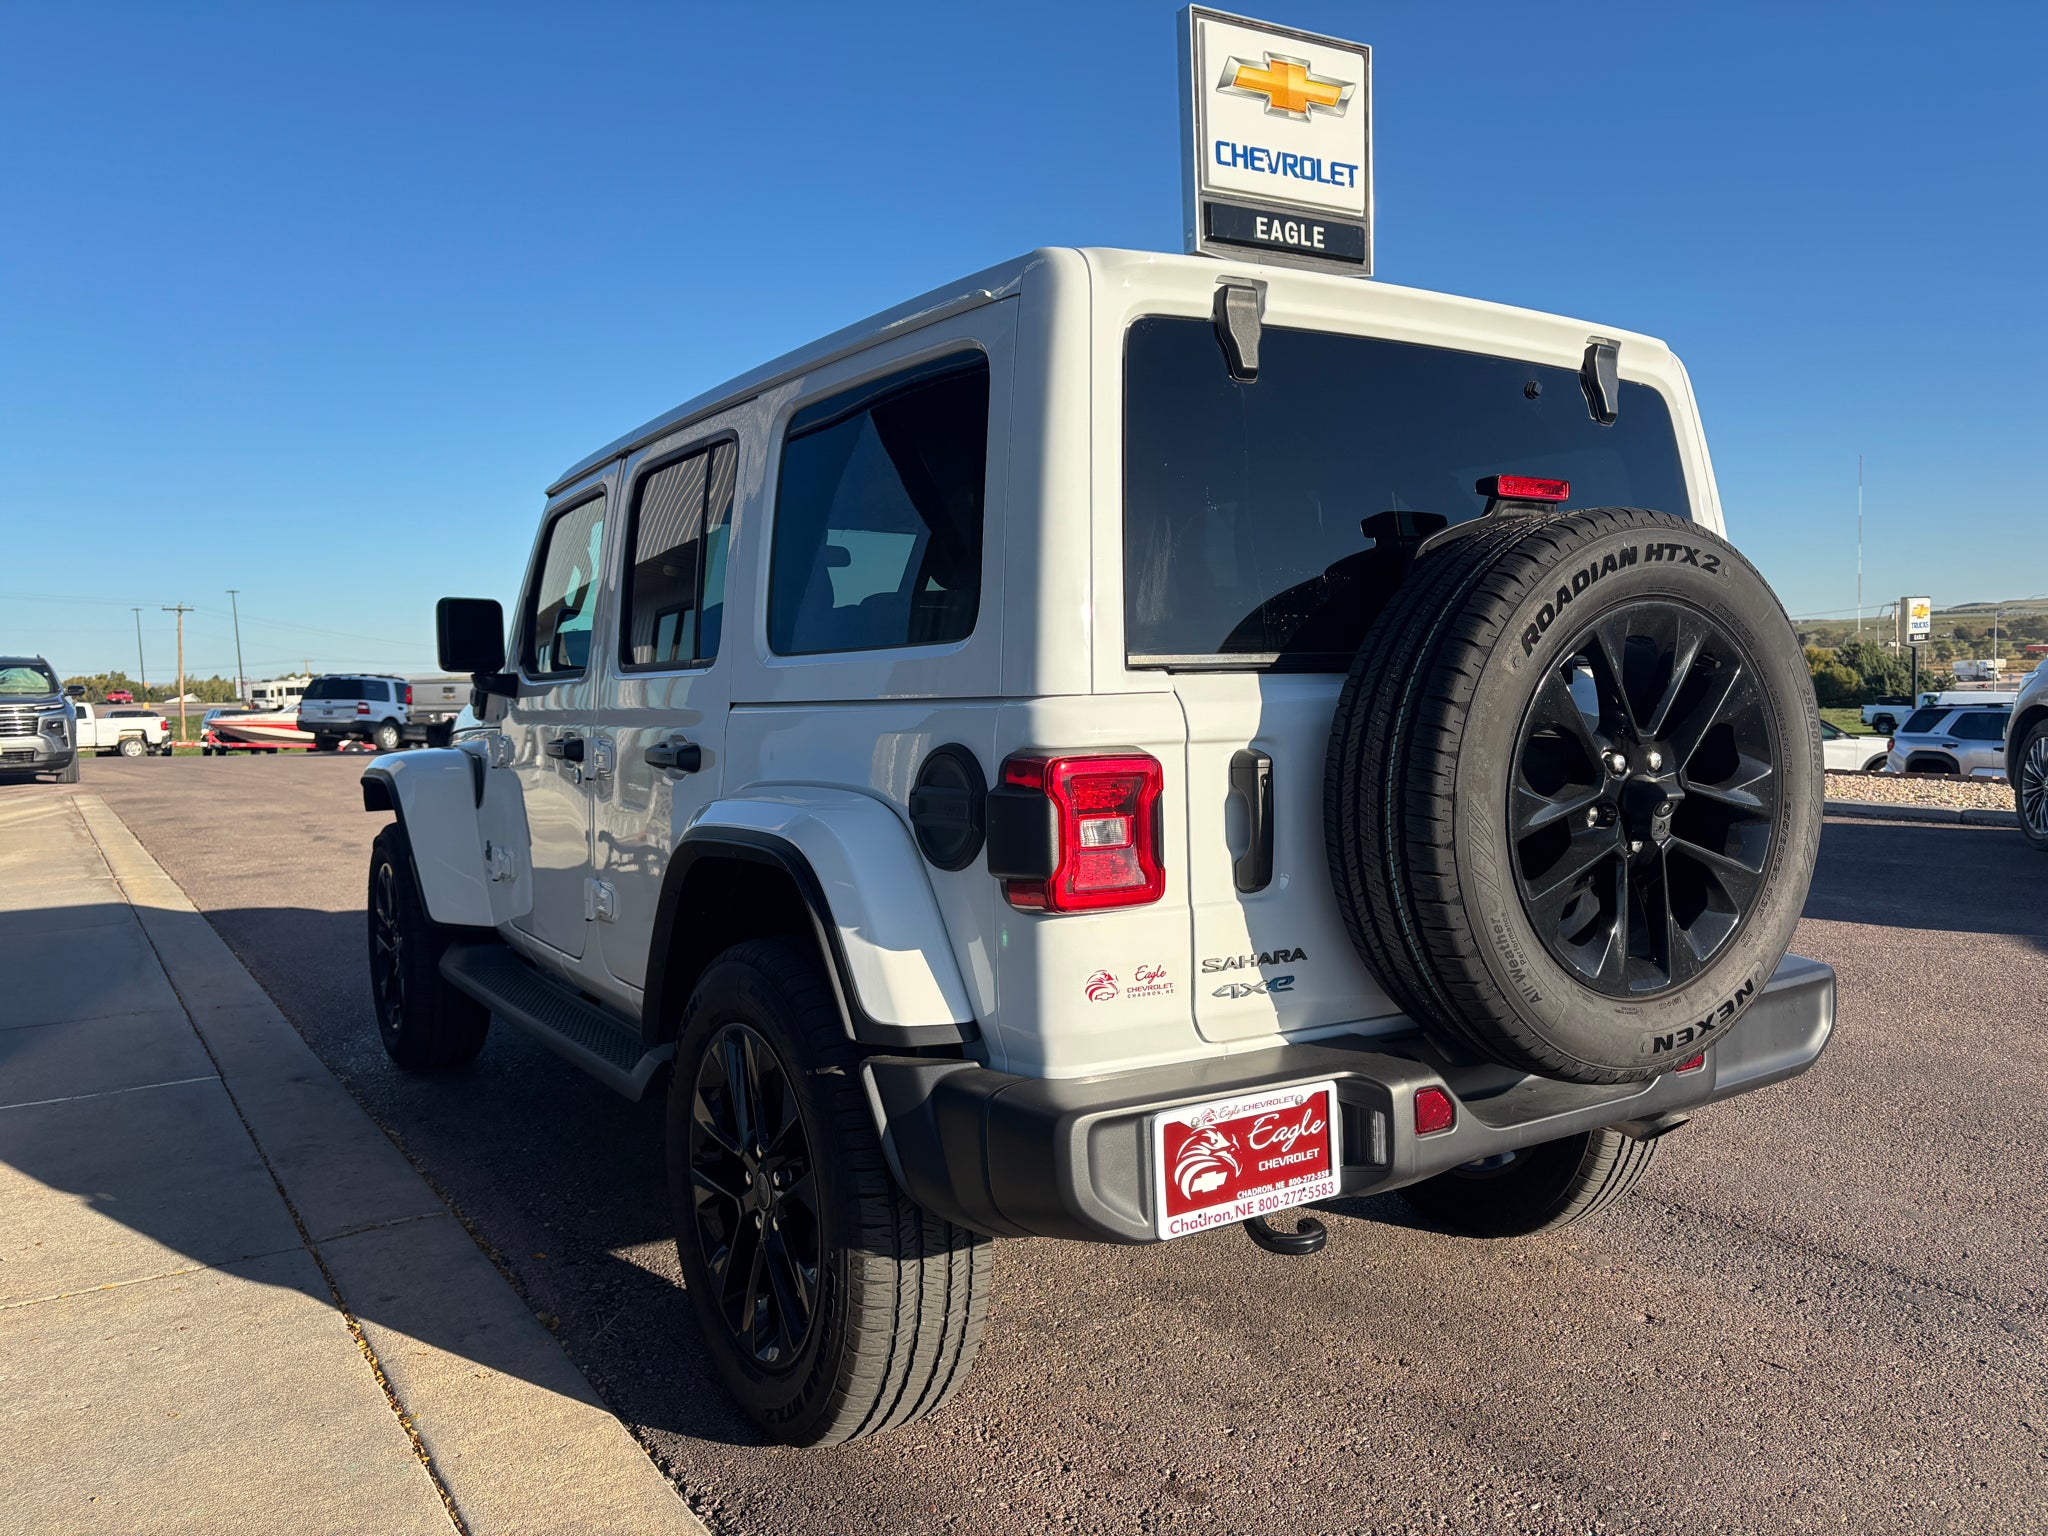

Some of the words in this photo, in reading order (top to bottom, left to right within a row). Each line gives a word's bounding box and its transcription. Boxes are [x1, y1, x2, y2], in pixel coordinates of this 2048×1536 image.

[1215, 140, 1358, 188] CHEVROLET
[1255, 216, 1325, 249] EAGLE
[1521, 545, 1638, 658] ROADIAN
[1644, 543, 1721, 575] HTX2
[1501, 911, 1527, 966] Performance
[1135, 964, 1167, 984] Eagle
[1201, 947, 1308, 974] SAHARA
[1491, 917, 1543, 1004] All-Weather
[1127, 982, 1174, 993] CHEVROLET
[1653, 978, 1754, 1054] NEXEN
[1219, 1105, 1241, 1120] Eagle
[1243, 1095, 1296, 1112] CHEVROLET
[1248, 1108, 1326, 1152] Eagle
[1258, 1148, 1320, 1171] CHEVROLET
[1258, 1181, 1334, 1212] 800-272-5583
